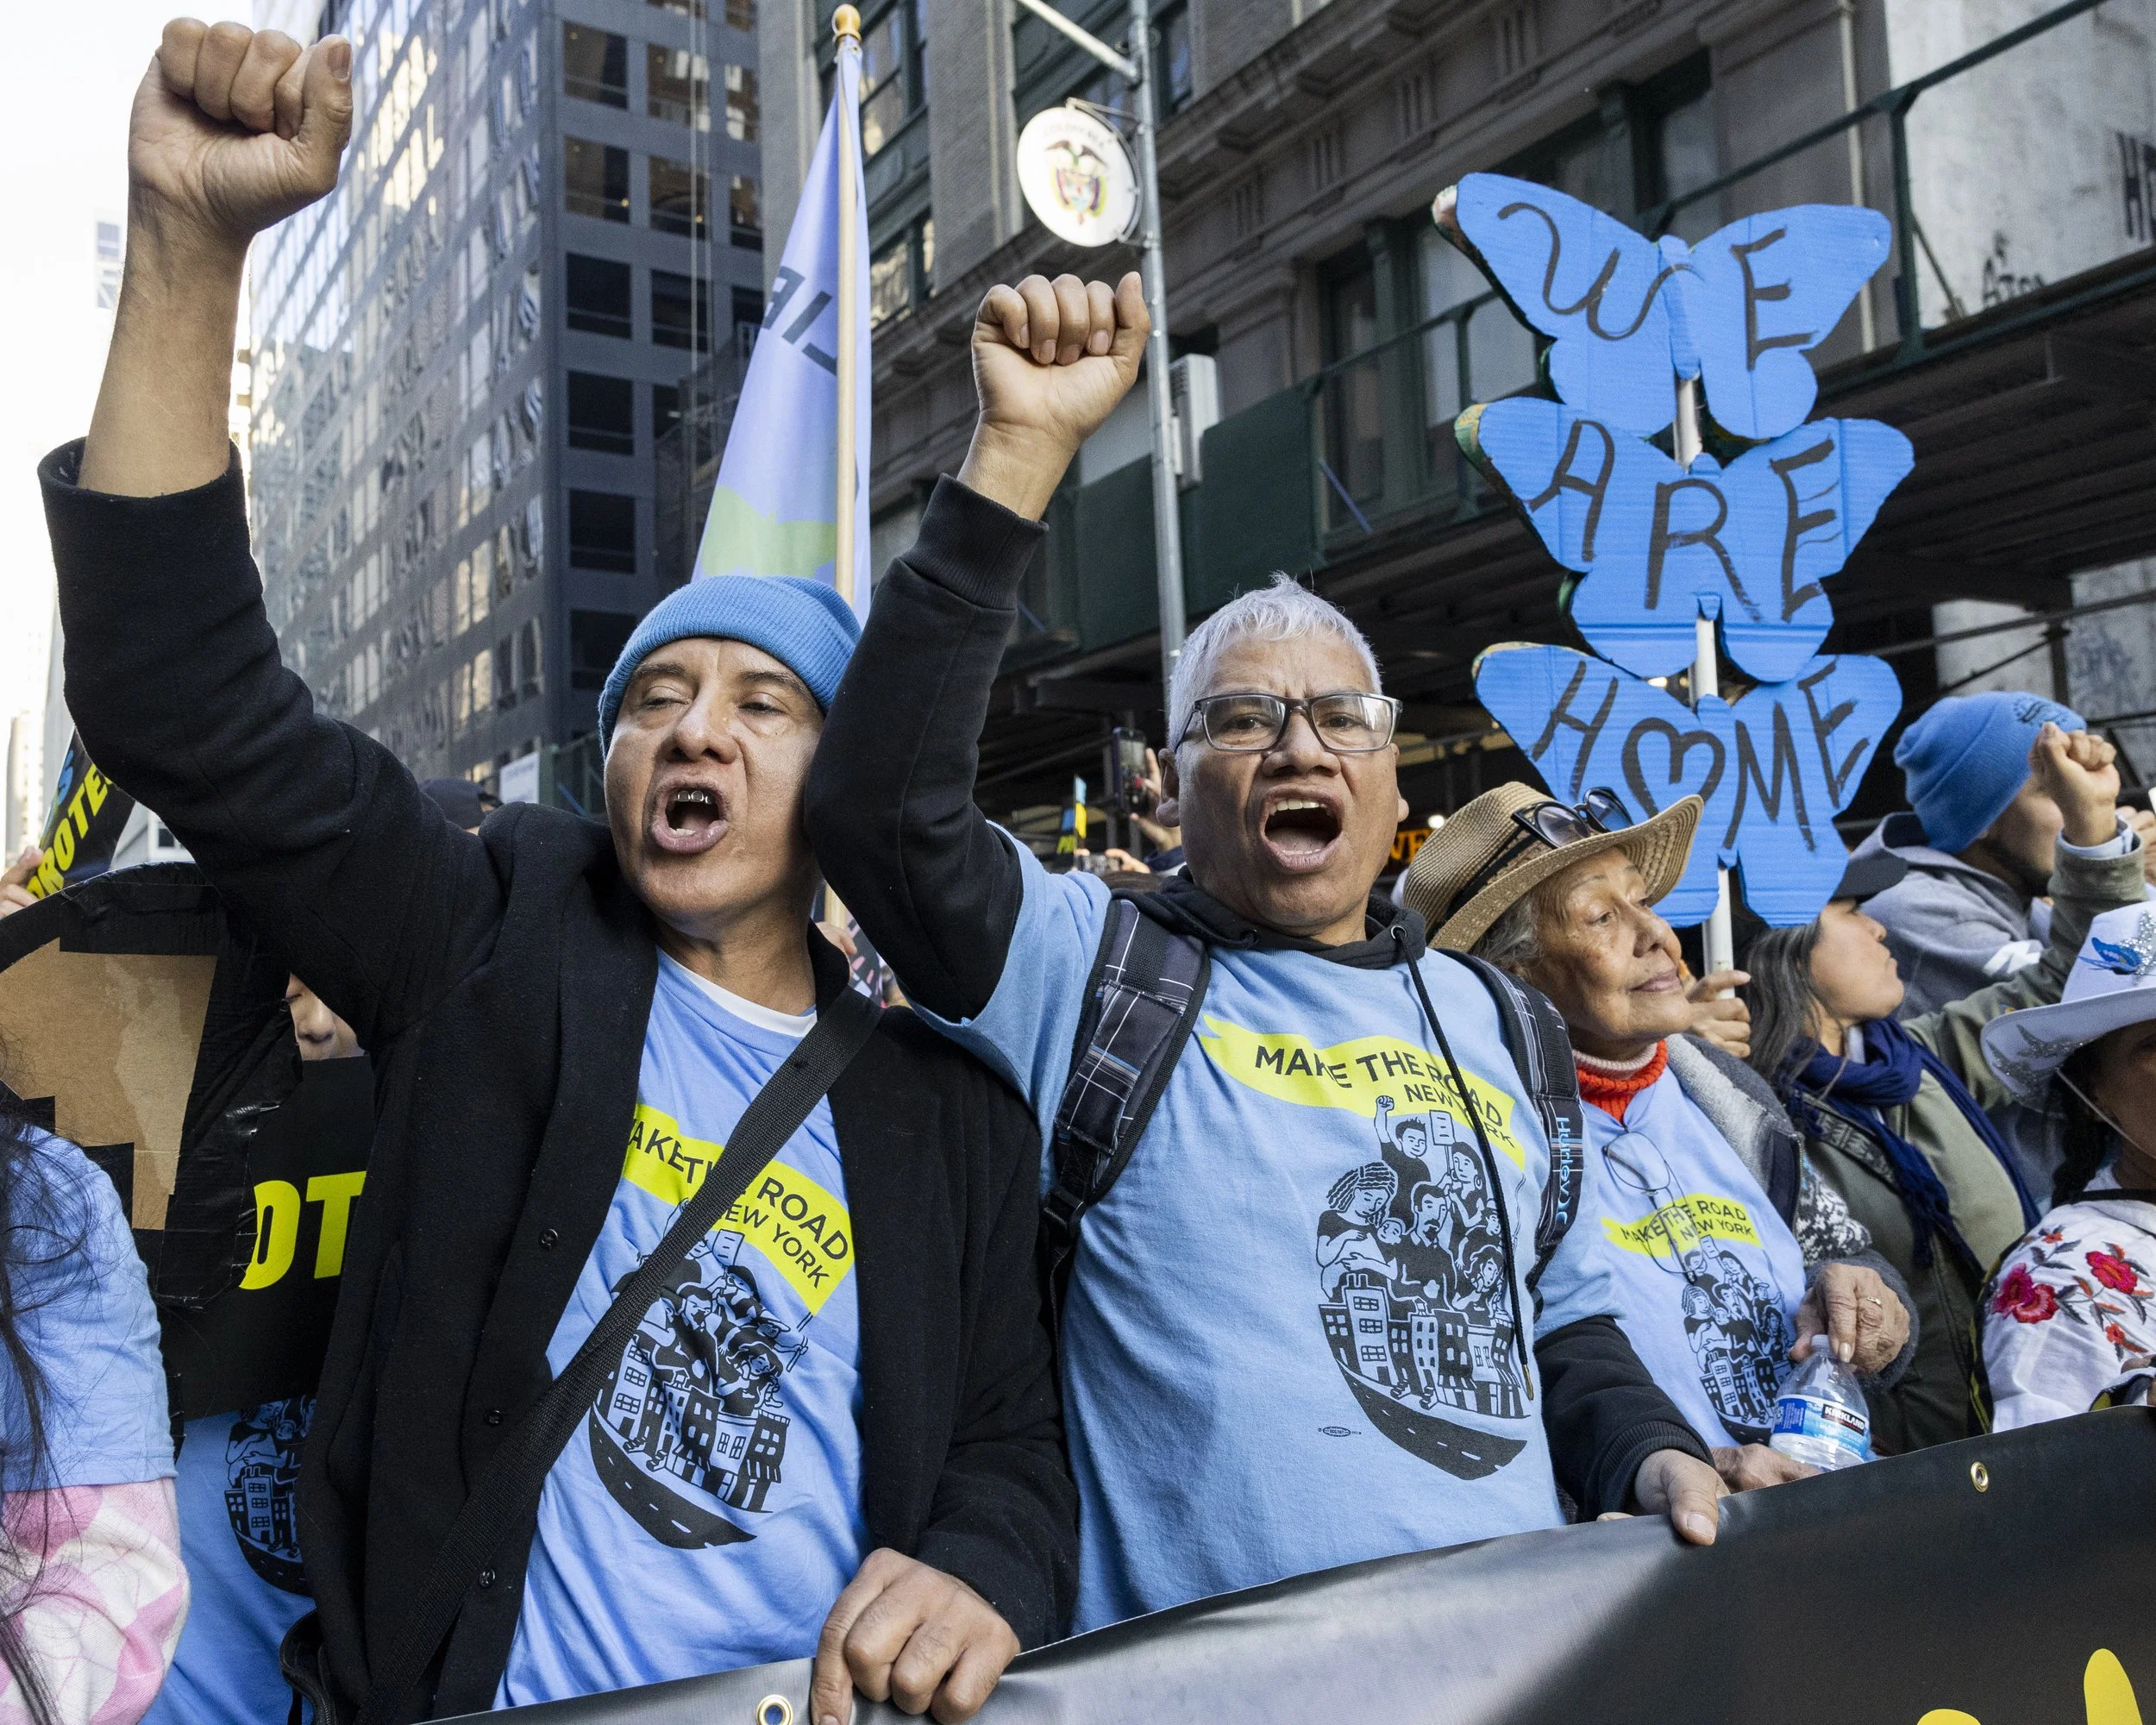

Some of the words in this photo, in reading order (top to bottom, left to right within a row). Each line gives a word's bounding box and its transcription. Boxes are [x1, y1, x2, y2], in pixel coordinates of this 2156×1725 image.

[1497, 202, 1820, 372] WE
[1528, 420, 1841, 623] ARE
[1356, 1051, 1425, 1082] THE
[1404, 1083, 1454, 1108] NEW
[1556, 1117, 1574, 1196] Hurley
[628, 1119, 686, 1173] AKE
[755, 1176, 849, 1260] ROAD
[1696, 1200, 1746, 1221] ROAD
[723, 1204, 770, 1229] EW
[772, 1223, 830, 1289] YORK
[1716, 1219, 1754, 1239] YORK
[1824, 1406, 1865, 1429] KIRKLAND
